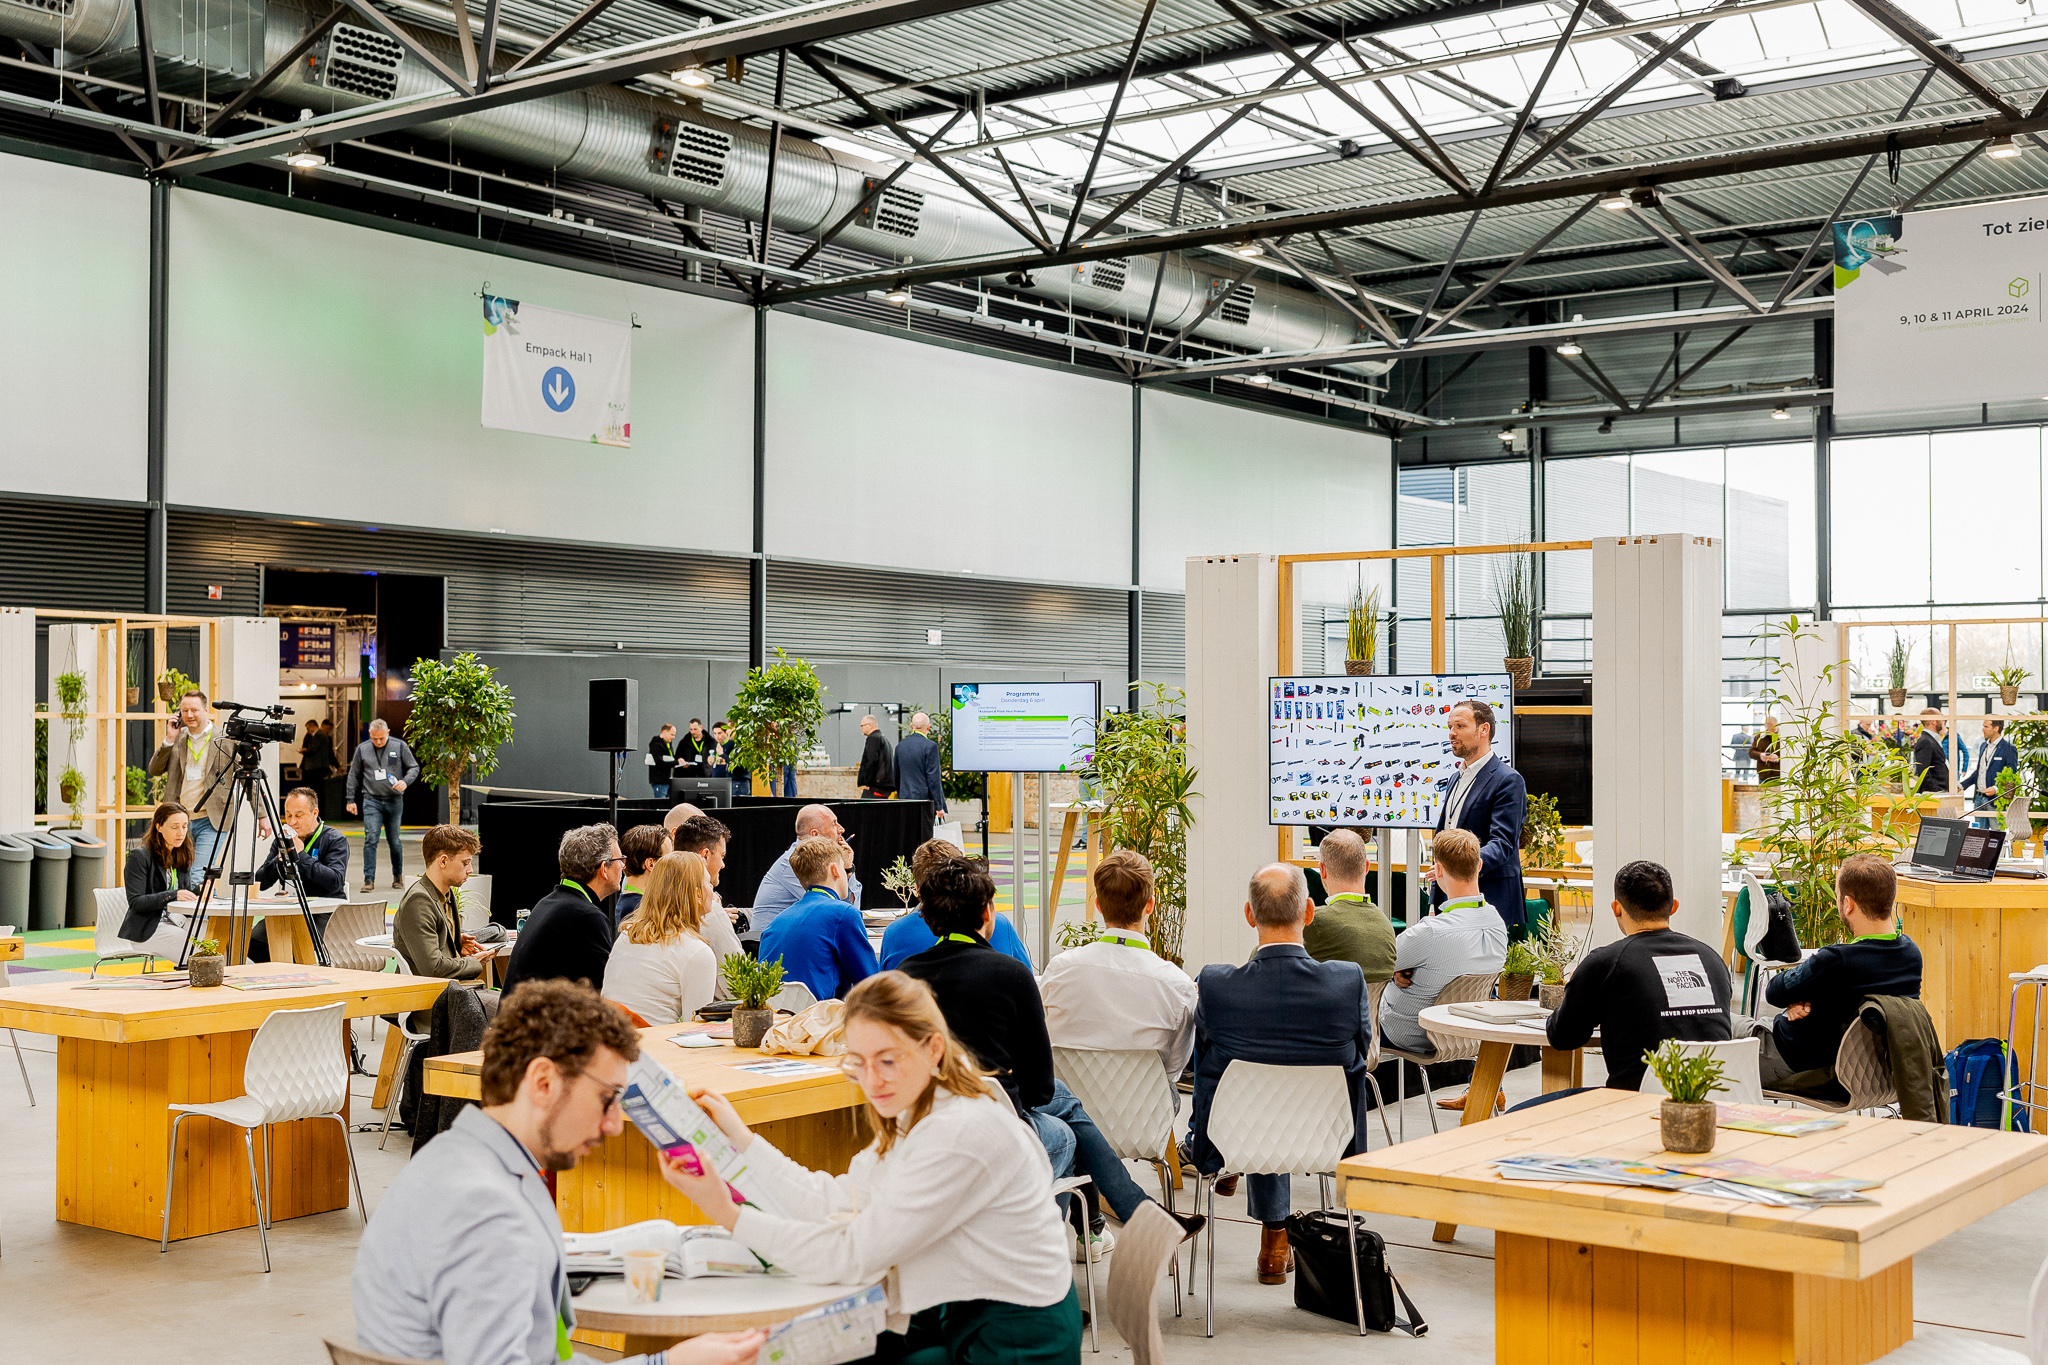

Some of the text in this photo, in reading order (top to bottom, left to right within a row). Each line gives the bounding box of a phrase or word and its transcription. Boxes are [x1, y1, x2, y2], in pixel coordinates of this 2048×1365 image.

[1982, 221, 2012, 237] Tot
[1900, 303, 2029, 326] 9, 10 & 11 APRIL 2024
[1918, 316, 2029, 332] Evenementenhal Gorinchem
[525, 342, 592, 363] Empack Hal 1
